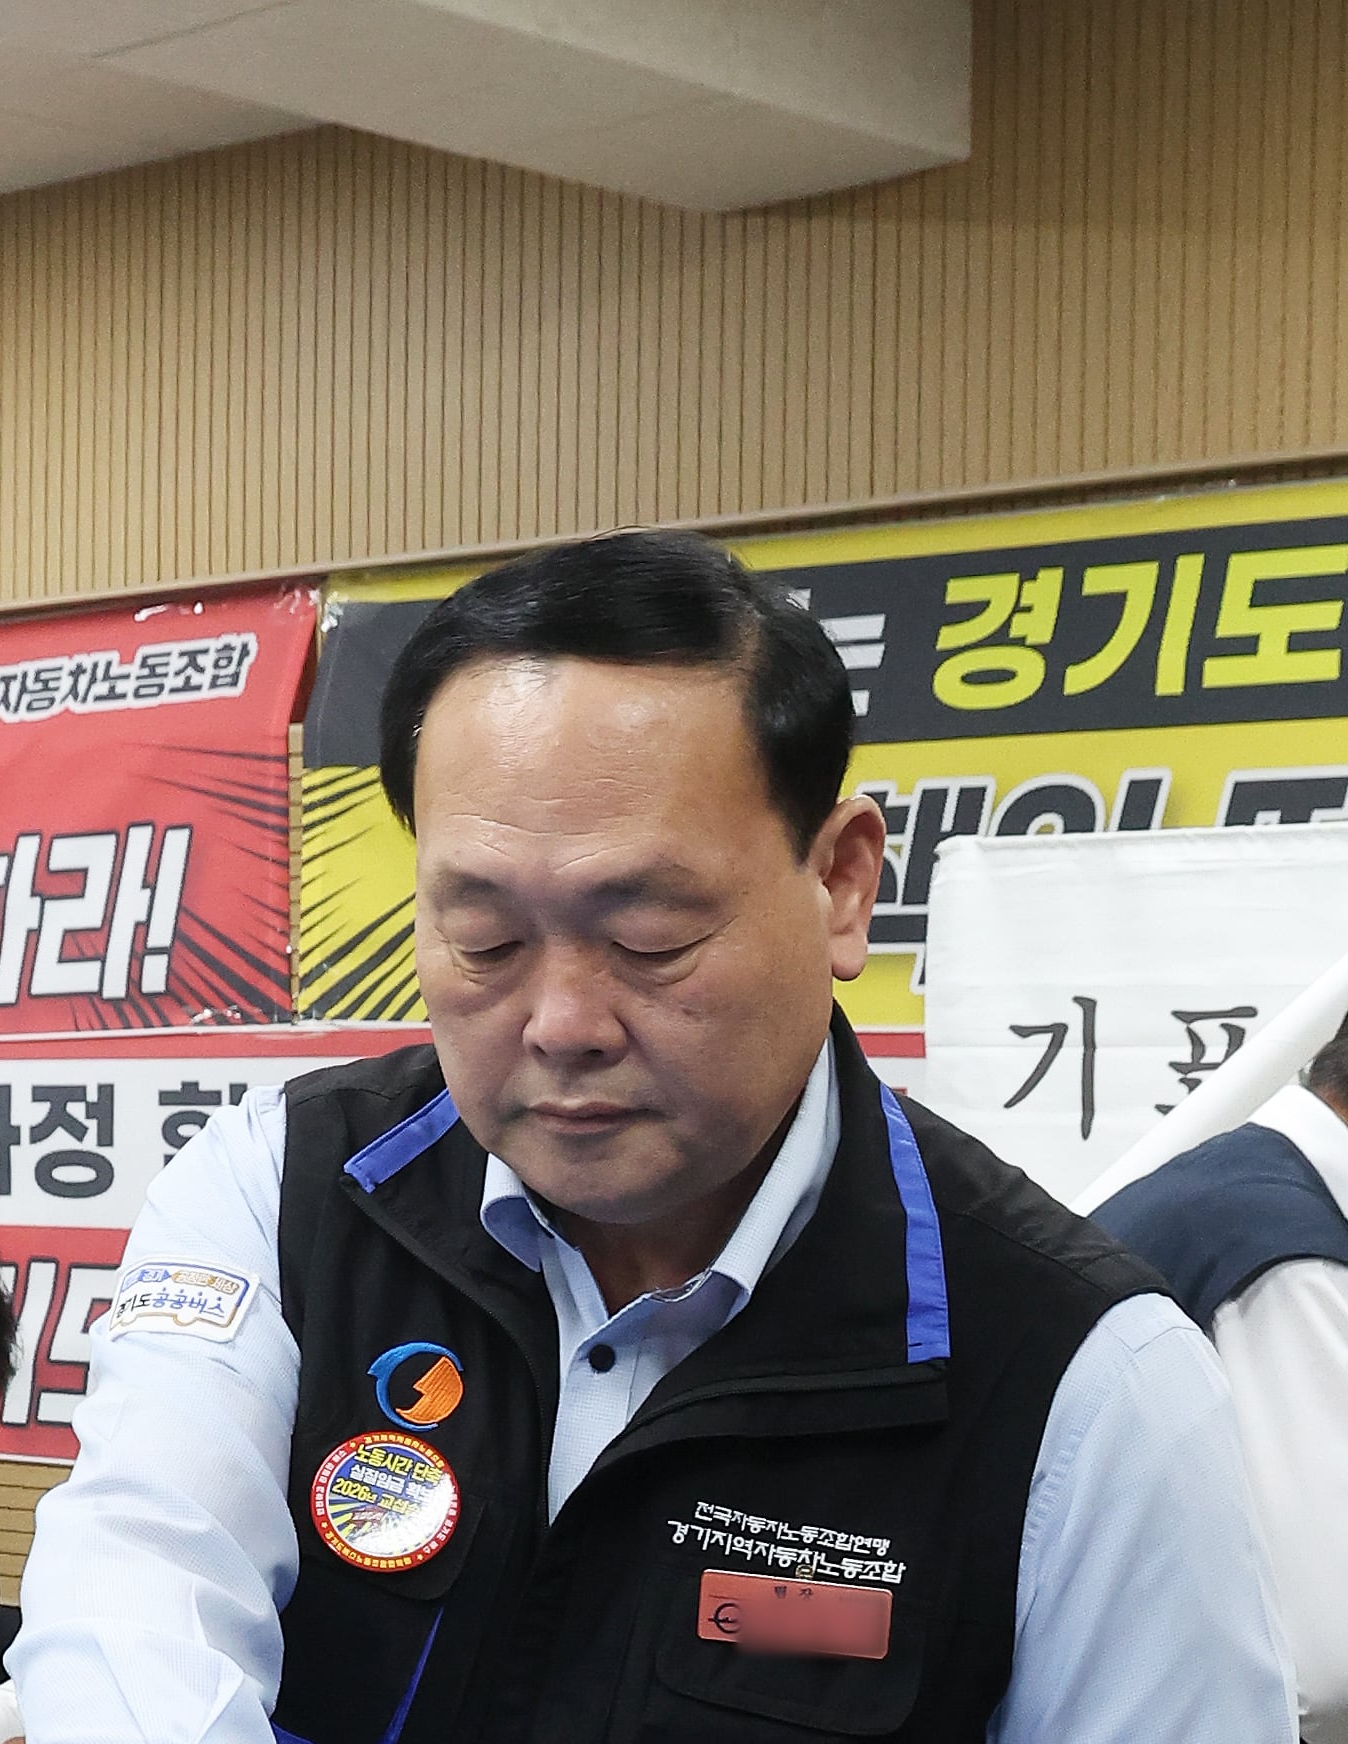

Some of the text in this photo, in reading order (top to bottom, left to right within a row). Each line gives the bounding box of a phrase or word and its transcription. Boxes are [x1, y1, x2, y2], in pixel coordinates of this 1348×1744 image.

[932, 543, 1348, 711] 경기도
[350, 1464, 405, 1494] 실질임금
[354, 1444, 442, 1485] 노동시간 단축
[332, 1478, 377, 1503] 2026년
[667, 1519, 907, 1584] 경기지역자동차노동조합
